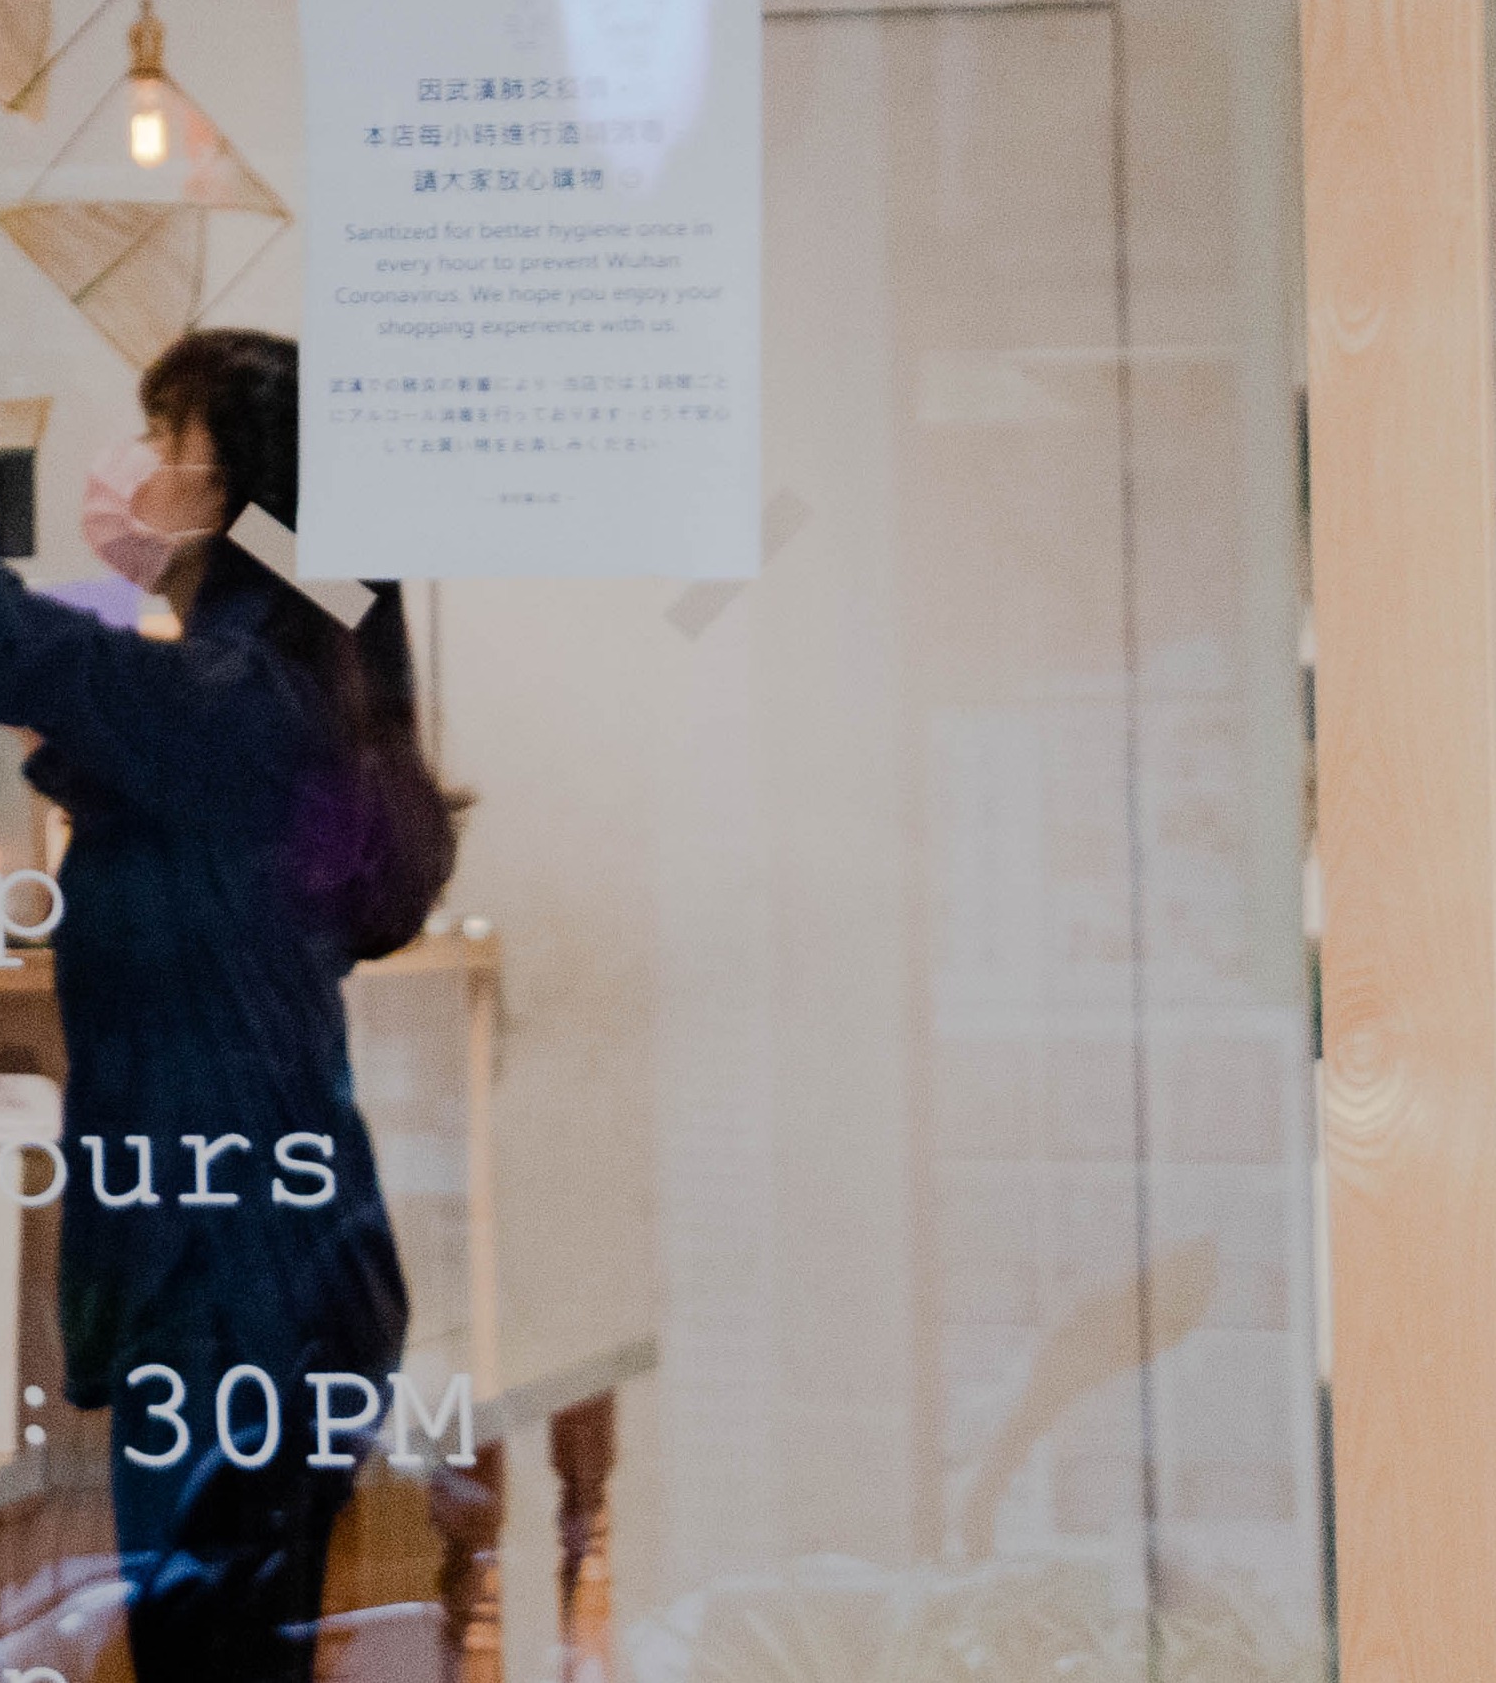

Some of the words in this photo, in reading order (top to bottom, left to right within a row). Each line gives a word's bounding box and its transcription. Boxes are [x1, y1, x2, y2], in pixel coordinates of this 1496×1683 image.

[345, 223, 437, 241] Sanitized
[444, 222, 473, 240] for
[479, 222, 542, 240] better
[548, 222, 631, 242] hygiene
[636, 222, 688, 237] once
[693, 221, 713, 236] in
[376, 258, 430, 275] every
[438, 255, 487, 271] hour
[493, 256, 514, 271] to
[519, 255, 599, 275] prevent
[605, 253, 681, 268] Wuhan
[469, 286, 502, 302] We
[508, 286, 561, 304] hope
[567, 288, 606, 304] you
[612, 286, 668, 305] enjoy
[675, 286, 723, 304] your
[377, 319, 474, 338] shopping
[481, 319, 593, 337] experience
[601, 318, 643, 333] with
